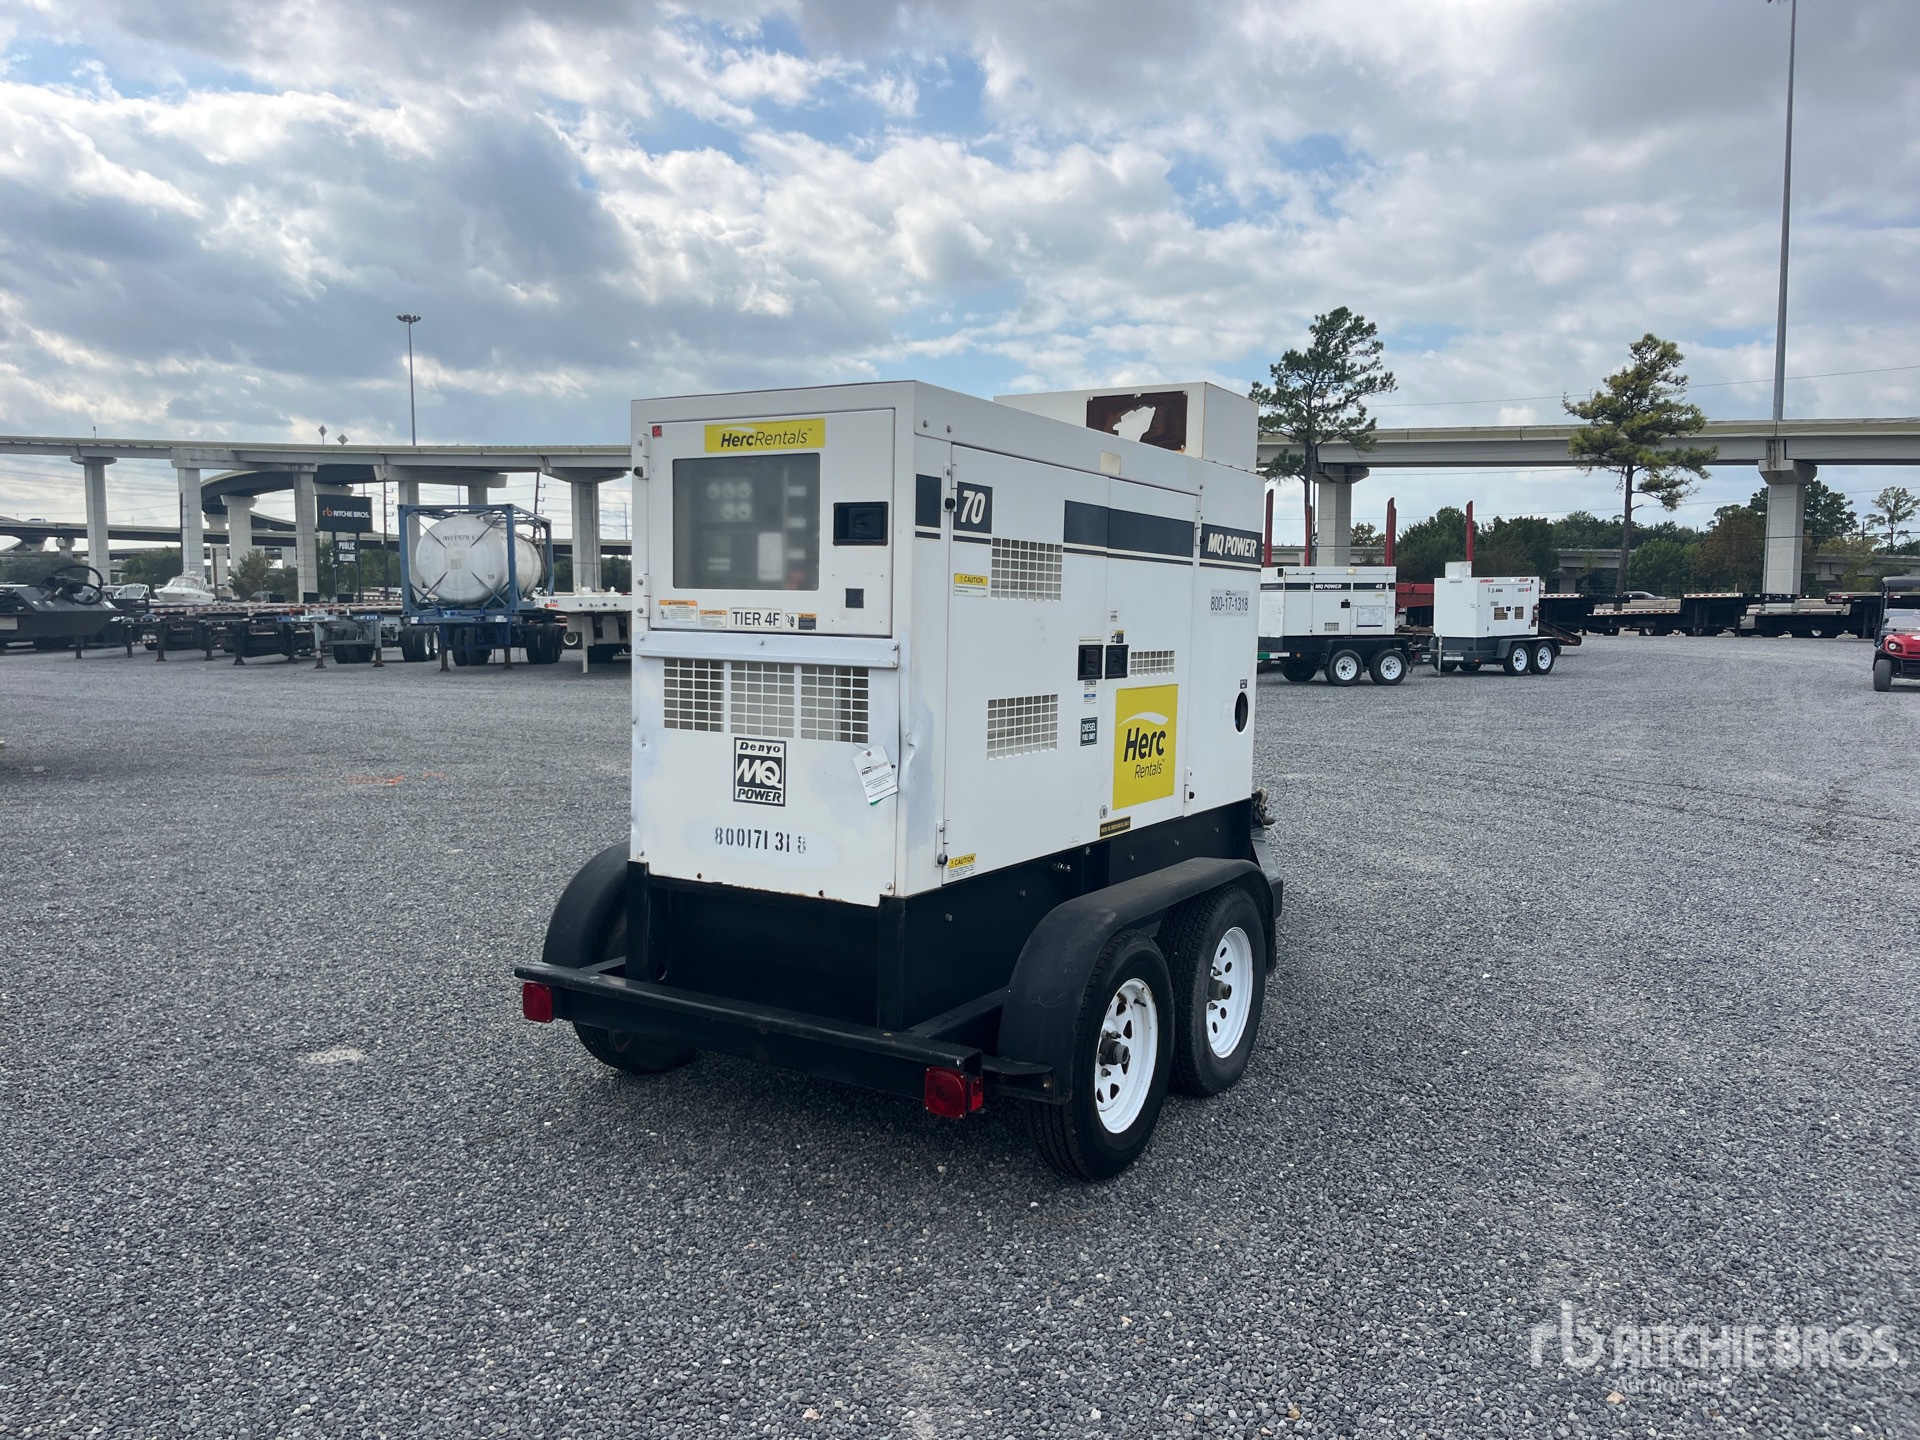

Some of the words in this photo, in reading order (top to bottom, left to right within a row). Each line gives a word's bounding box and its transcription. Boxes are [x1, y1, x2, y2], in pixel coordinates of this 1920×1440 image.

[720, 429, 808, 447] HercRentals
[960, 490, 986, 524] 70
[1207, 533, 1225, 557] MQ
[1224, 535, 1257, 558] POWER
[963, 575, 984, 584] CAUTION
[1210, 596, 1249, 611] 800-17-1318
[733, 611, 761, 626] TIER
[764, 612, 781, 627] 4F
[1082, 723, 1096, 732] DIESEL
[740, 742, 781, 754] Denyo
[1123, 727, 1166, 762] Herc
[737, 758, 782, 788] MQ
[1135, 760, 1162, 779] Rentals
[737, 788, 782, 802] POWER
[954, 855, 975, 866] CAUTION
